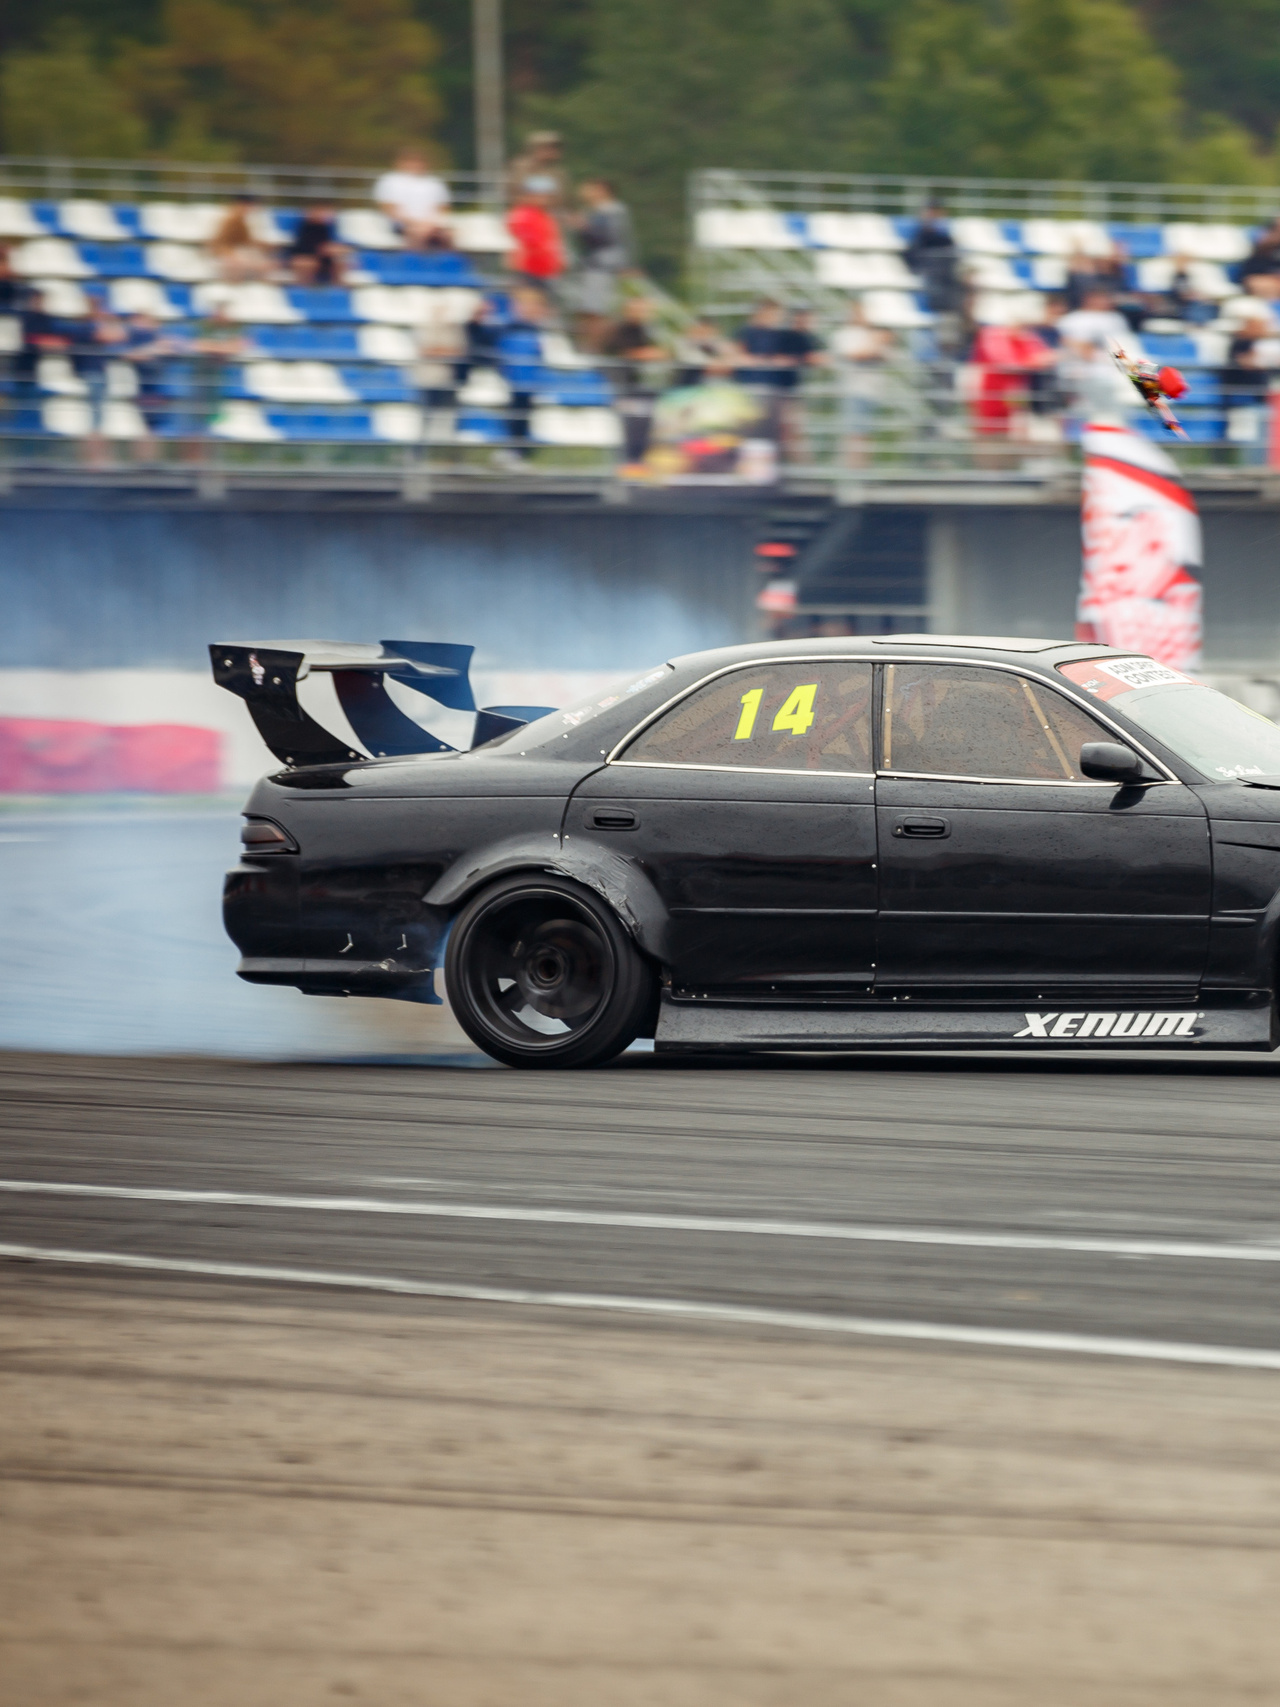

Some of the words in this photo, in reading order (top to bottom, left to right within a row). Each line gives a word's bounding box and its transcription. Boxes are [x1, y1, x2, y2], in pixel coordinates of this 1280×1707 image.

[1124, 670, 1176, 684] CONTEST
[734, 683, 818, 740] 14
[1013, 1012, 1198, 1037] XENUM
